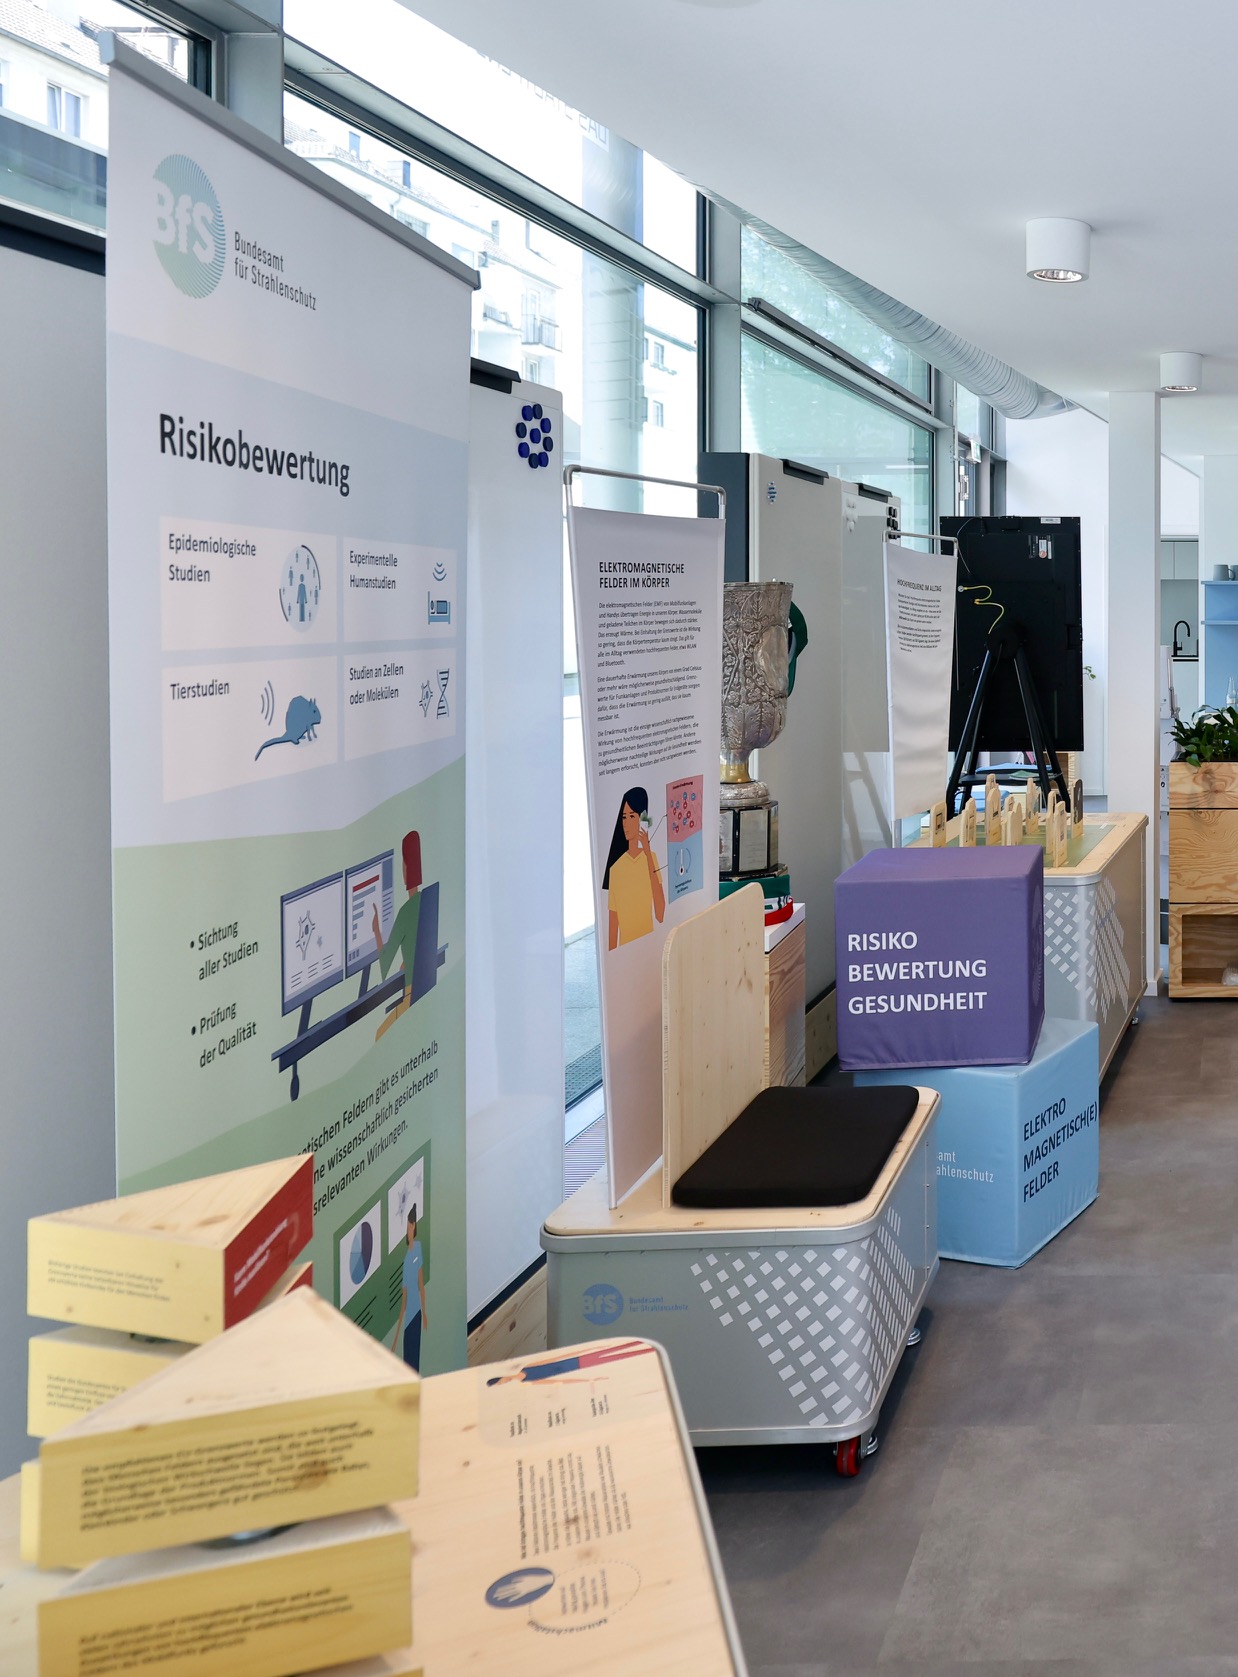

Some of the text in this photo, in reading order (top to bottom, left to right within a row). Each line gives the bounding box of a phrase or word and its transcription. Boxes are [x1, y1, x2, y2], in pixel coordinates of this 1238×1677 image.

[153, 181, 215, 264] BfS
[234, 231, 284, 273] Bundesamt
[234, 257, 316, 311] für Strahlenschutz
[159, 413, 350, 496] Risikobewertung
[169, 534, 256, 558] Epidemiologische
[350, 551, 398, 567] Experimentelle
[600, 562, 684, 573] ELEKTROMAGNETISCHE
[169, 564, 210, 582] Studien
[350, 575, 396, 590] Humanstudien
[600, 575, 670, 588] FELDER IM KÖRPER
[350, 663, 404, 680] Studien an Zellen
[170, 680, 230, 700] Tierstudien
[350, 686, 399, 705] oder Molekülen
[198, 921, 238, 951] Sichtung
[847, 931, 918, 951] RISIKO
[199, 940, 259, 981] aller Studien
[848, 959, 987, 982] BEWERTUNG
[848, 991, 988, 1015] GESUNDHEIT
[200, 1002, 237, 1034] Prüfung
[200, 1022, 257, 1068] der Qualität
[298, 1040, 438, 1156] tischen Feldern gibt es unterhalb
[328, 1102, 393, 1171] wissenschaftlich
[395, 1068, 438, 1115] gesicherten
[1024, 1098, 1066, 1142] ELEKTRO
[1024, 1101, 1098, 1172] MAGNETISCH(E)
[313, 1120, 408, 1216] srelevanten Wirkungen.
[938, 1152, 956, 1163] amt
[936, 1165, 994, 1183] ahlenschutz
[1024, 1161, 1059, 1203] FELDER
[582, 1294, 618, 1314] BfS
